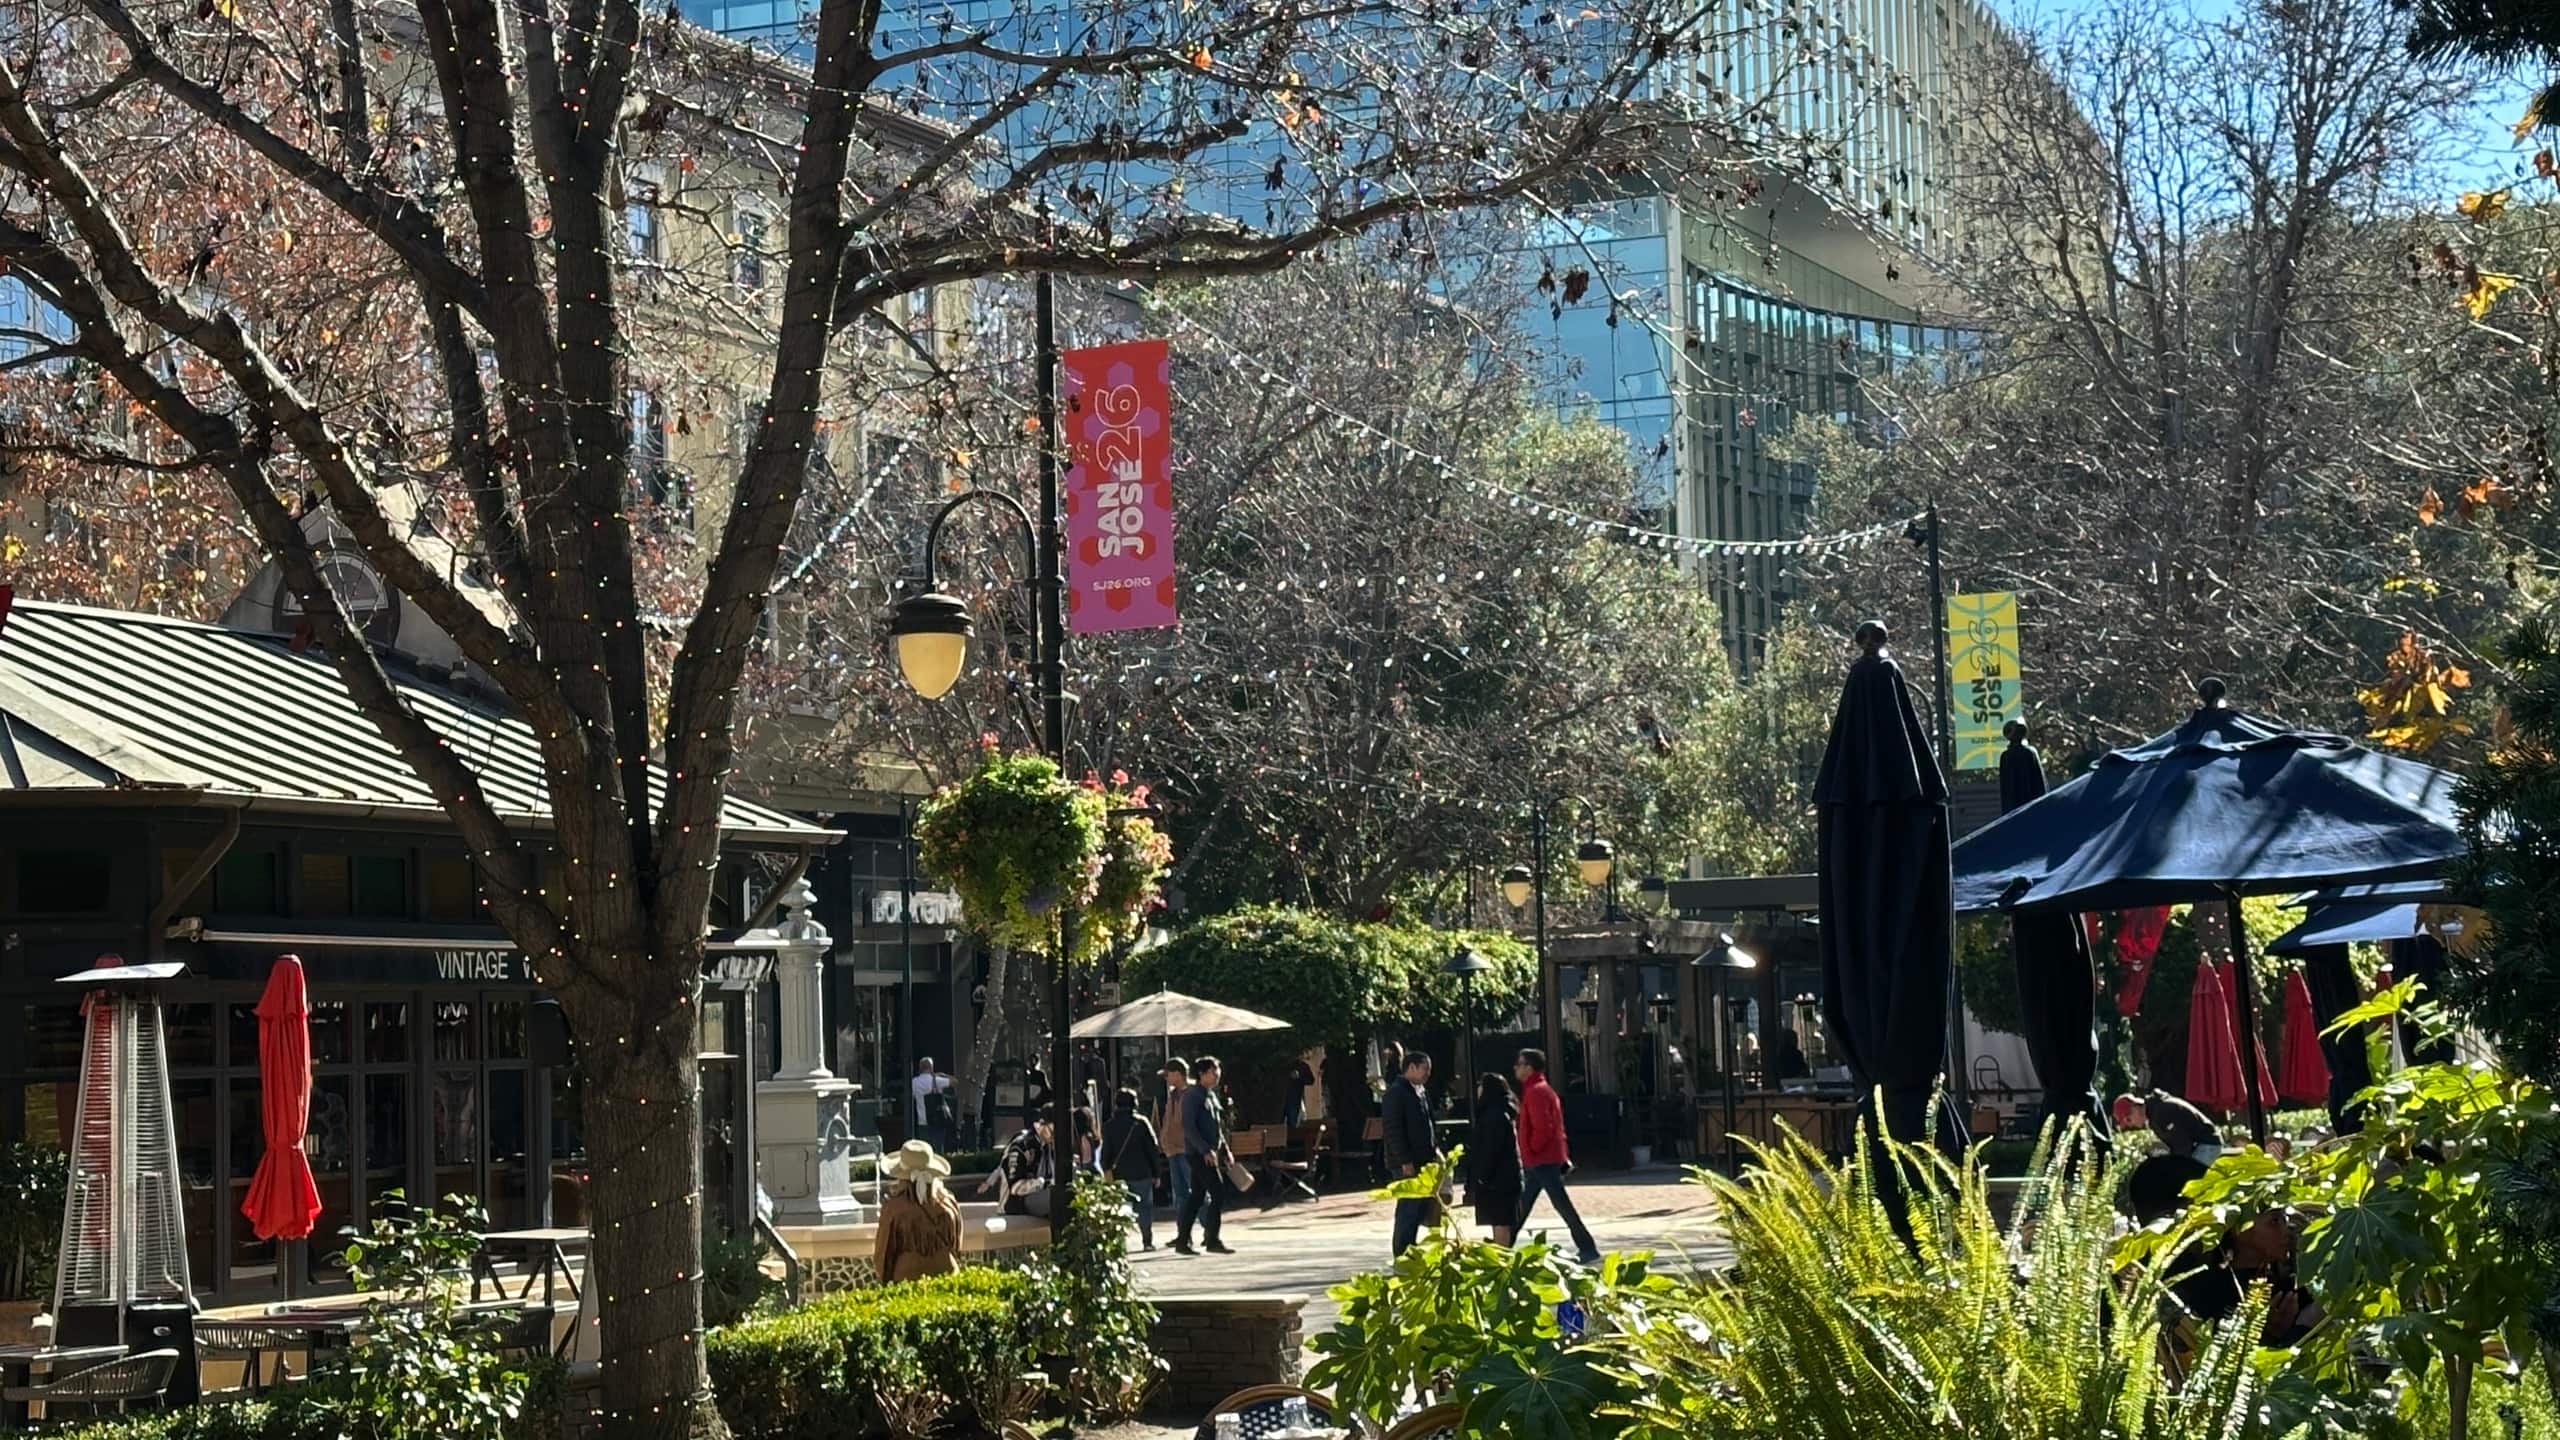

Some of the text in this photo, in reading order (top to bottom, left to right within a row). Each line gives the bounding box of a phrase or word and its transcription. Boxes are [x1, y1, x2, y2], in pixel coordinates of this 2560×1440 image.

[1095, 384, 1142, 472] 26
[1097, 482, 1120, 557] SAN
[1968, 618, 2001, 671] 26
[1971, 678, 1988, 724] SAN
[435, 951, 509, 979] VINTAGE
